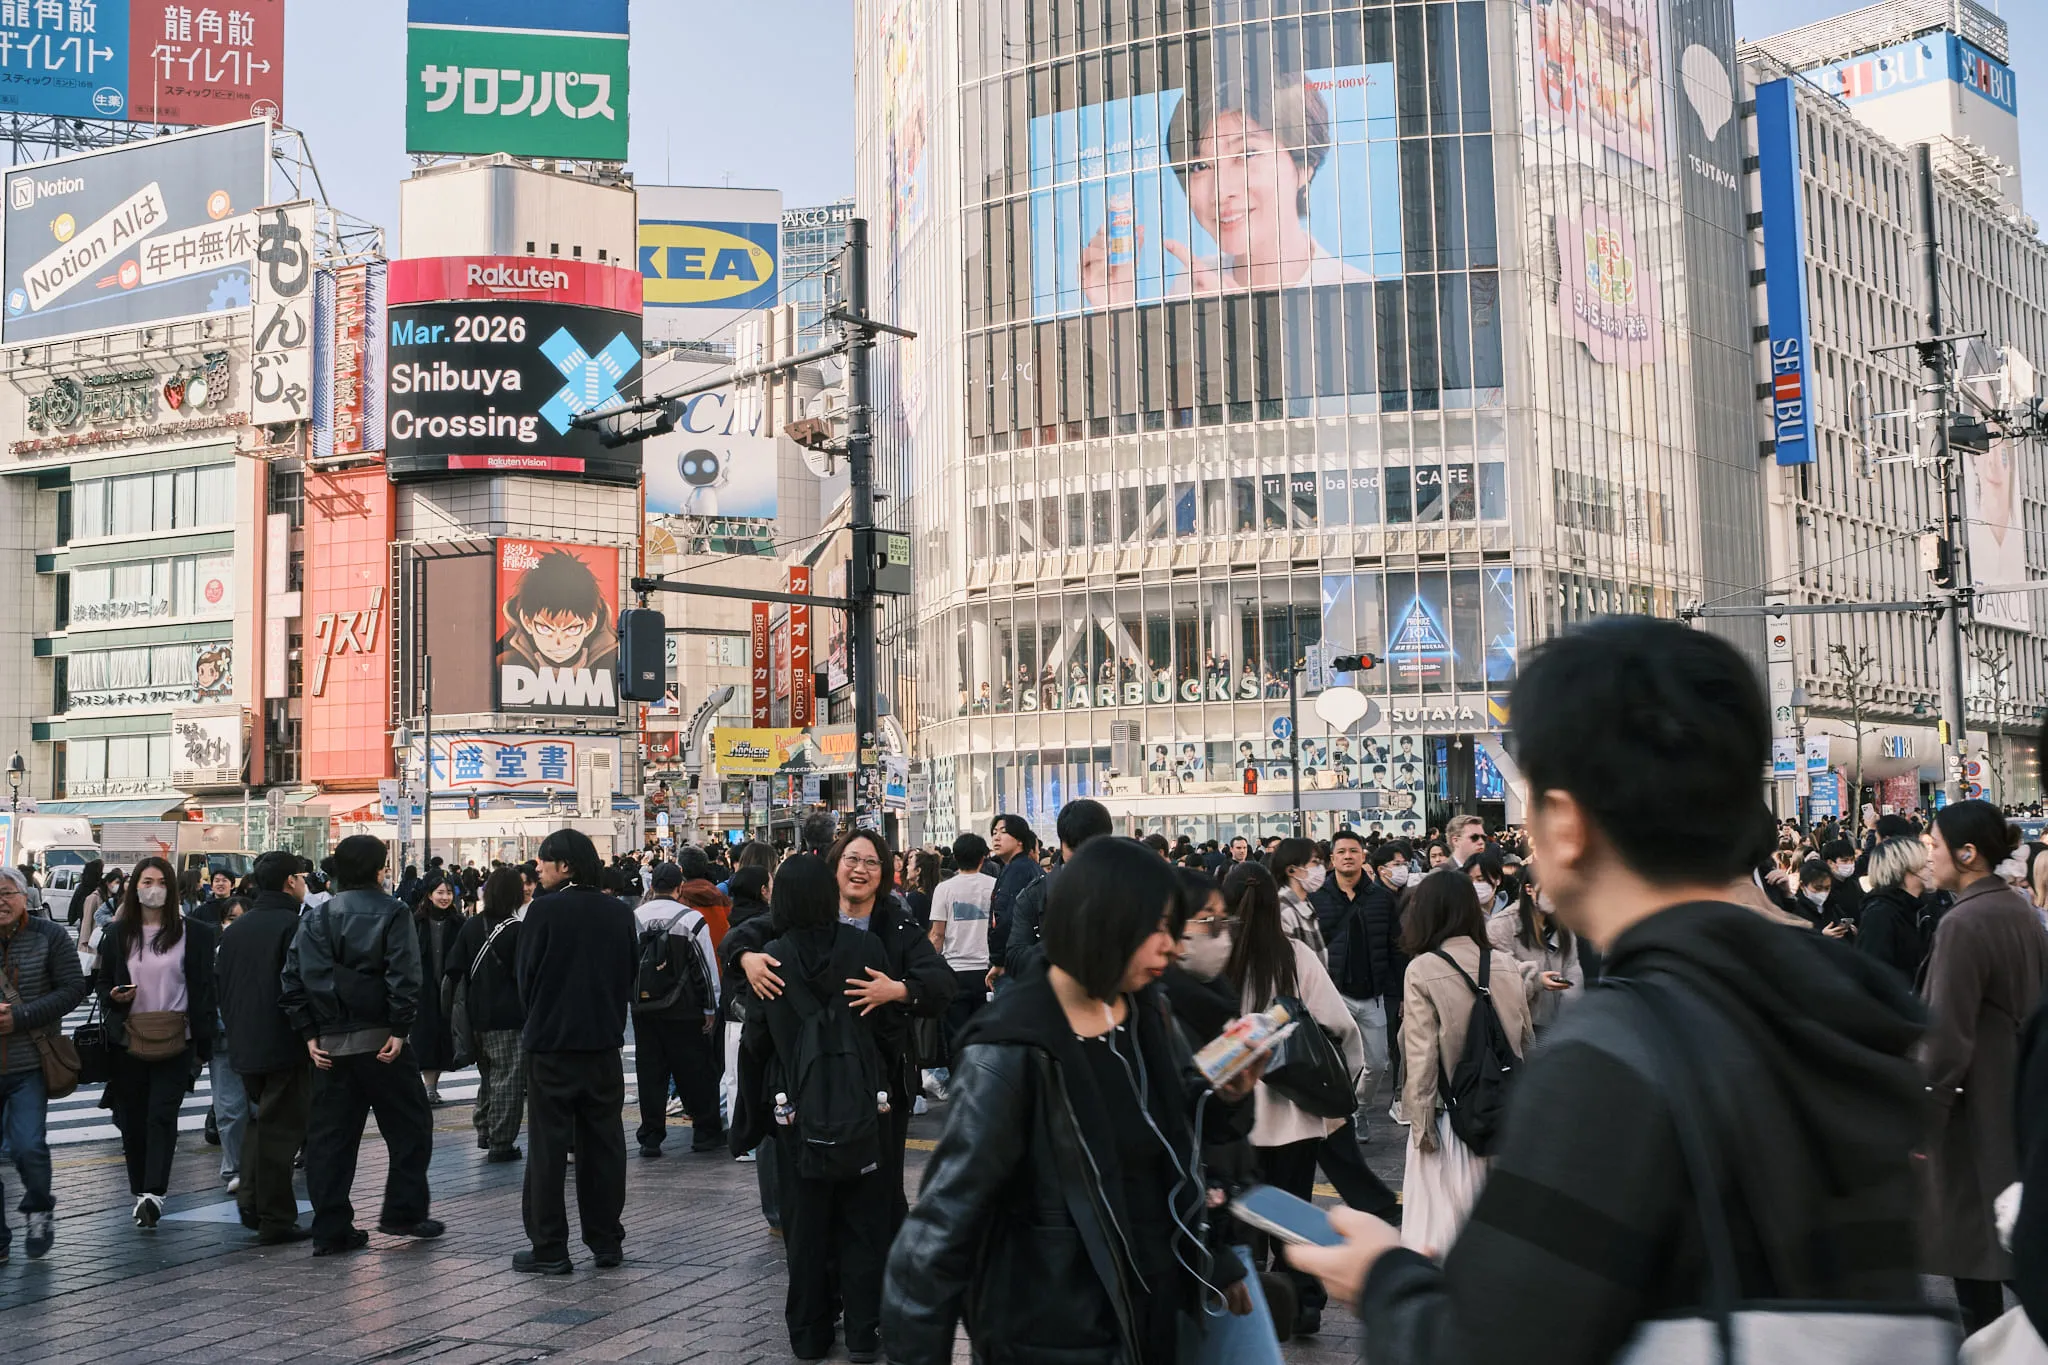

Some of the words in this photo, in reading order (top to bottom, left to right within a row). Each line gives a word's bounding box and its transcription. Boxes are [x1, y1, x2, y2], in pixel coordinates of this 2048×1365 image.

[1, 0, 97, 34] 龍角散
[164, 5, 255, 47] 龍角散
[165, 86, 211, 98] スティック
[421, 64, 615, 121] サロンパス
[1961, 47, 2012, 108] SEIBU
[95, 94, 121, 107] 生薬
[37, 176, 85, 200] Notion
[1688, 153, 1737, 192] TSUTAYA
[782, 208, 829, 228] PARCO
[29, 236, 107, 301] Notion
[112, 193, 161, 247] AIは
[146, 222, 252, 276] 年中無休
[639, 246, 760, 282] KEA
[467, 263, 569, 290] Rakuten
[255, 208, 310, 415] もんじゃ
[391, 319, 450, 347] Mar.
[454, 315, 527, 344] 2026
[391, 361, 522, 397] Shibuya
[1772, 338, 1805, 445] SEIBU
[390, 406, 539, 443] Crossing
[488, 451, 521, 467] Rakuten
[522, 452, 547, 468] Vision
[1264, 478, 1314, 495] Time
[1325, 470, 1380, 491] based
[1416, 468, 1468, 486] CAFE
[755, 613, 764, 632] BIG
[791, 577, 809, 659] カラオケ
[312, 586, 384, 697] クスリ
[755, 632, 764, 659] ECHO
[502, 664, 616, 707] DMM
[754, 667, 768, 720] カラオ
[793, 668, 804, 690] BIG
[1021, 676, 1259, 712] STARBUCKS
[793, 692, 804, 720] ECHO
[1380, 706, 1475, 722] TSUTAYA
[419, 744, 568, 781] 大盛堂書
[1883, 735, 1915, 759] SEIBU
